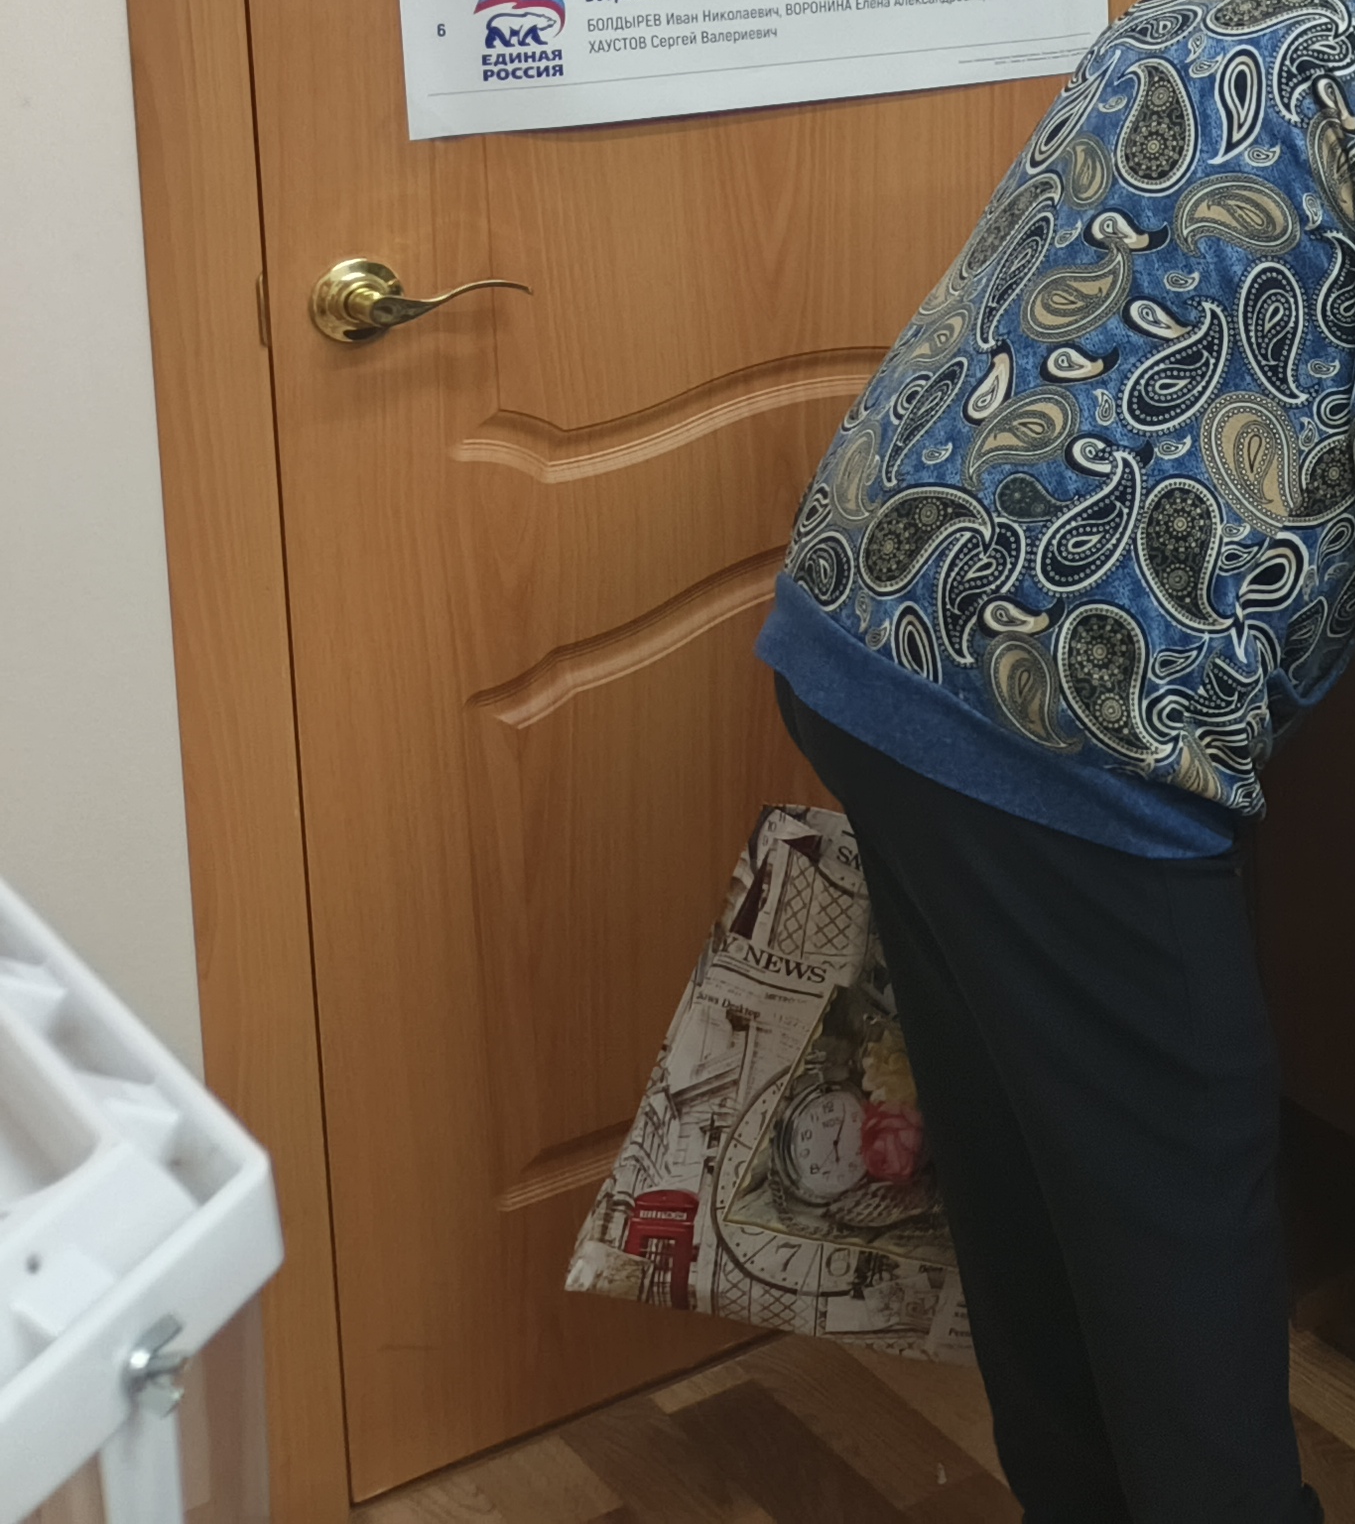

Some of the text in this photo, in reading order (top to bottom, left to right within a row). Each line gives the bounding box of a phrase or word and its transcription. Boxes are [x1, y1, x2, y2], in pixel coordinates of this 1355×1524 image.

[436, 23, 446, 37] 6
[481, 49, 563, 66] ЕДИНАЯ
[483, 64, 564, 82] РОССИЯ
[743, 943, 827, 984] NEWS
